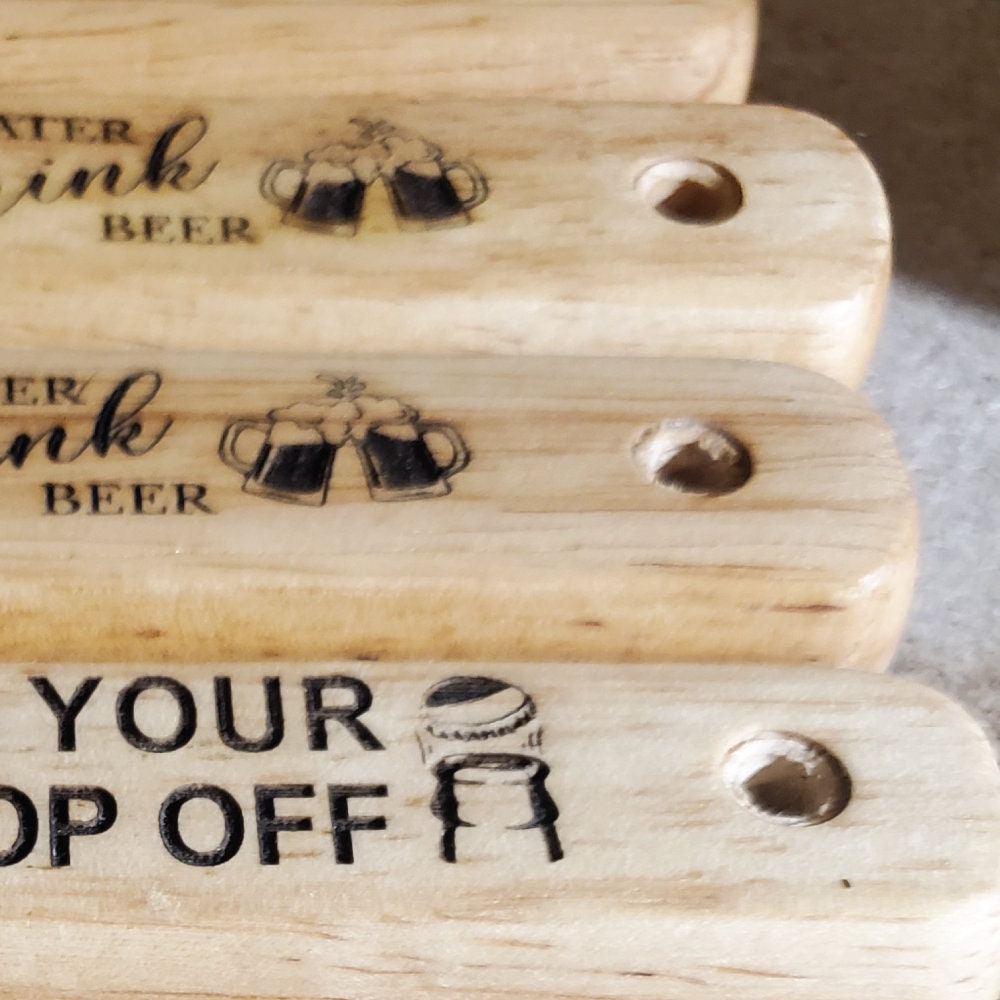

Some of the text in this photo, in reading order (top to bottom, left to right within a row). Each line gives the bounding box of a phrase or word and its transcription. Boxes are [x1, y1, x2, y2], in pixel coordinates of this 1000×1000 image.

[100, 213, 259, 246] BEER
[41, 481, 217, 516] BEER
[28, 674, 385, 753] YOUR
[158, 782, 389, 867] OFF
